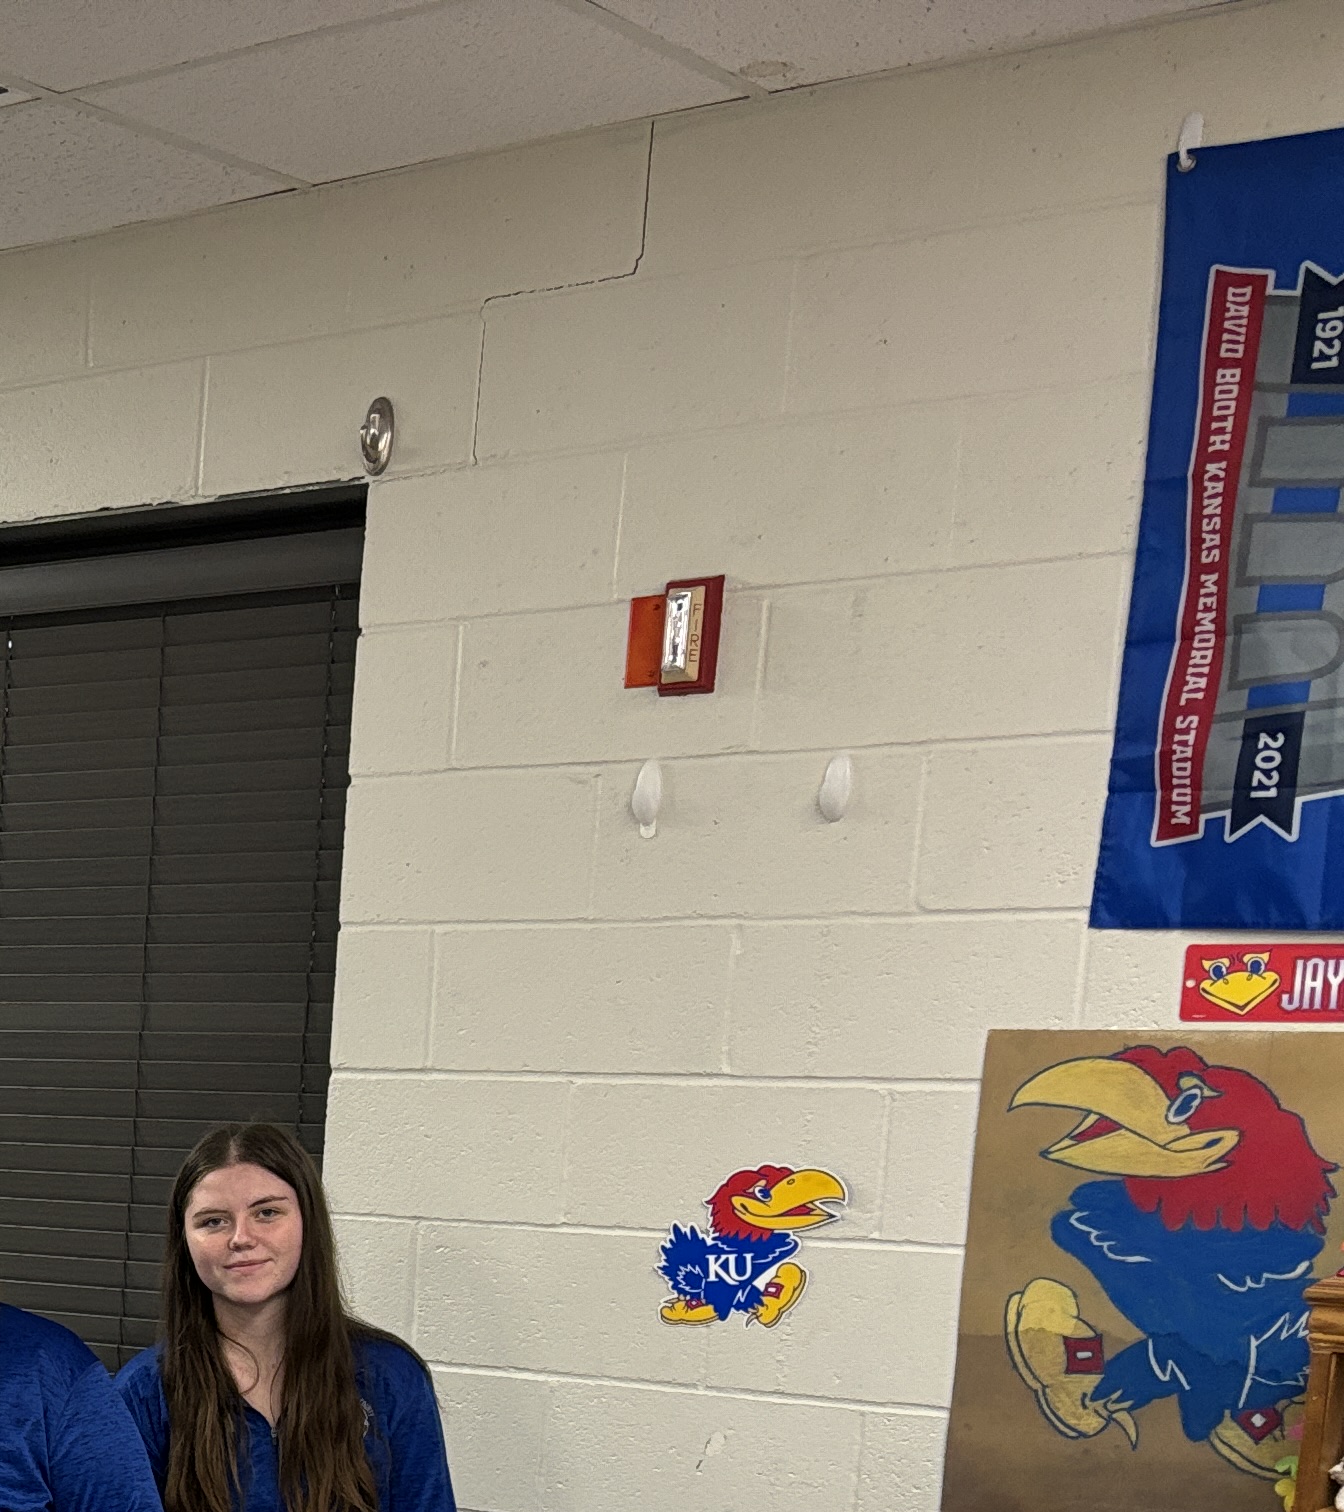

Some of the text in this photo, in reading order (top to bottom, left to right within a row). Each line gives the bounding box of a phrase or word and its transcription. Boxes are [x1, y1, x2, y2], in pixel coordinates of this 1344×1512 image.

[1312, 305, 1344, 370] 1921
[1170, 285, 1252, 826] DAVID BOOTH KANSAS MEMORIAL STADIUM
[688, 603, 702, 663] FIRE
[1250, 732, 1285, 800] 2021
[1281, 957, 1344, 1011] JAY
[706, 1252, 755, 1286] KU
